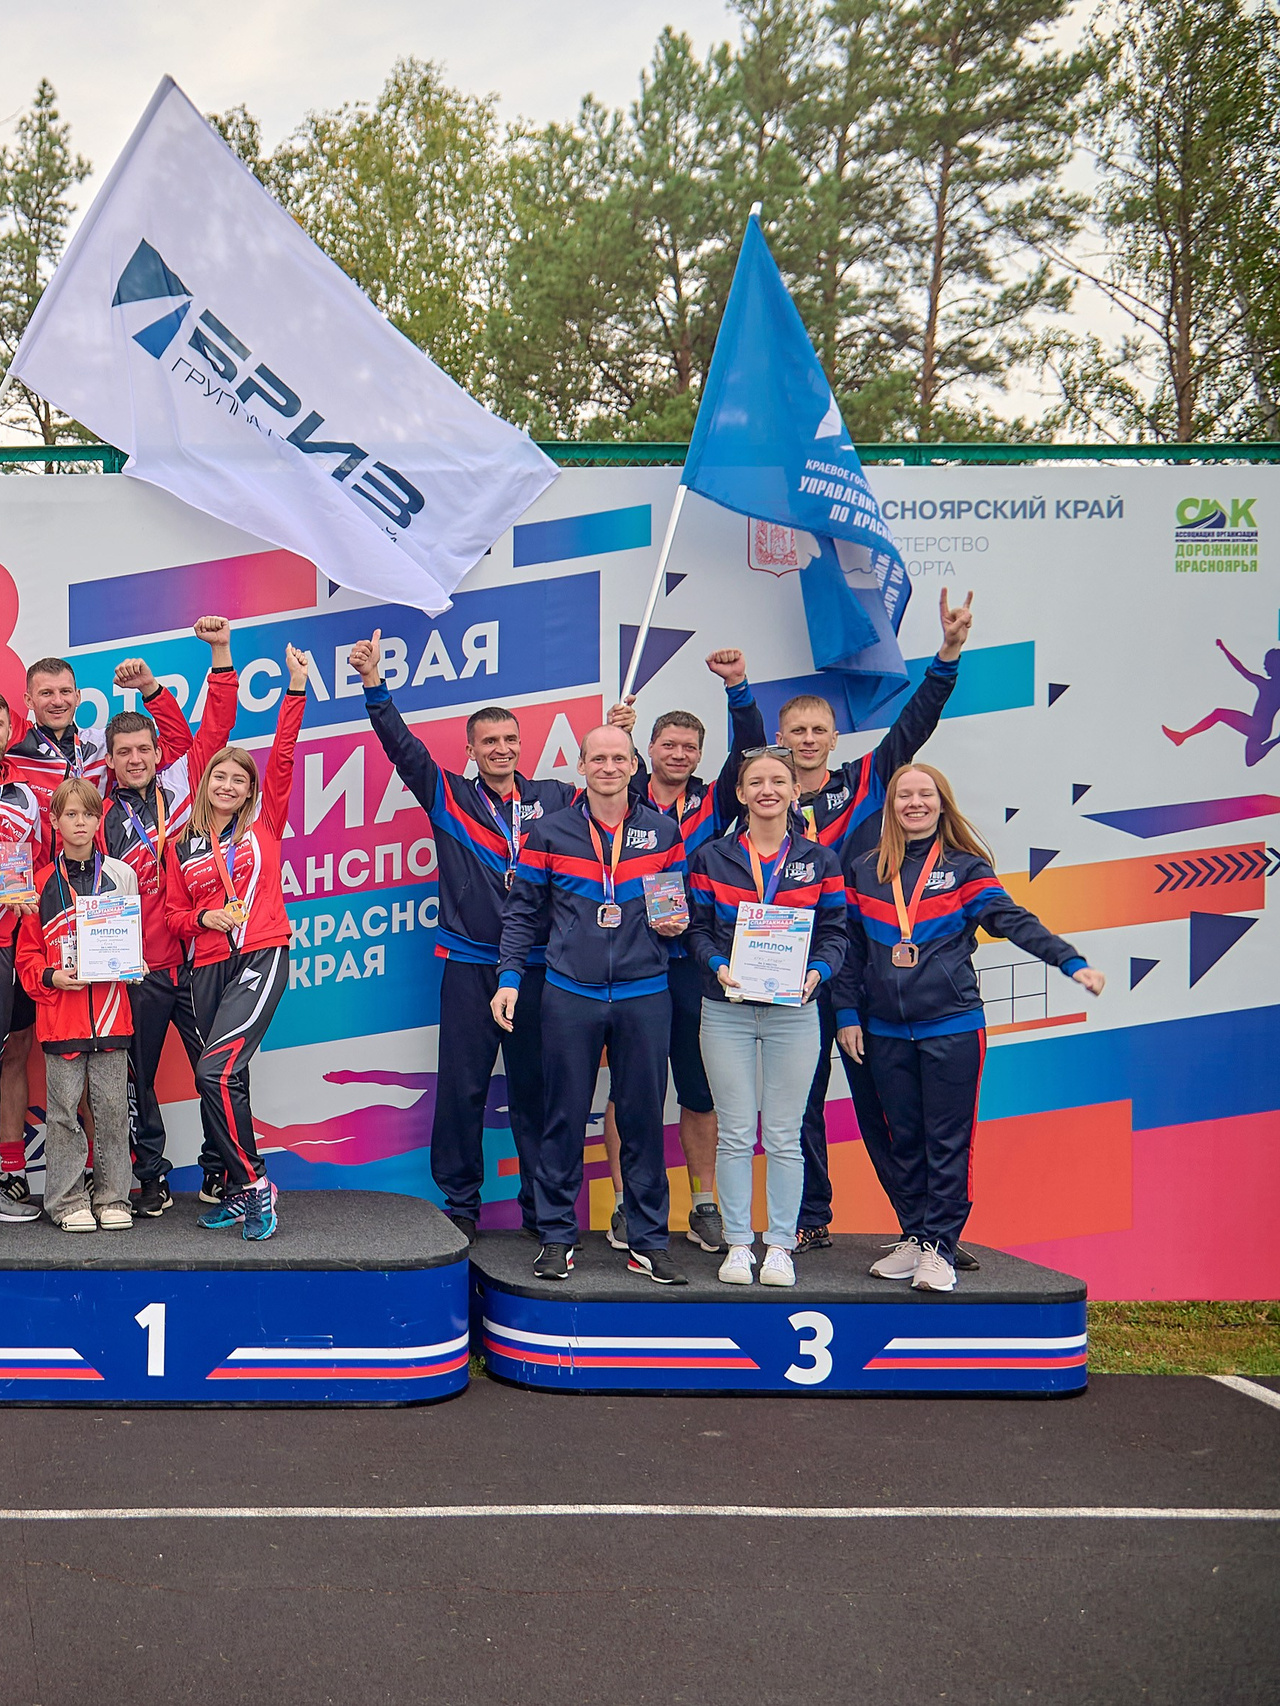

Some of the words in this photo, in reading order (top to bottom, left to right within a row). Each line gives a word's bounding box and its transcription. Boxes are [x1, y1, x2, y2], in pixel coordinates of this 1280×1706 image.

[171, 356, 262, 432] ГРУПА
[188, 308, 425, 529] БРИЗ
[805, 458, 850, 479] КРАЕВОЕ
[849, 472, 874, 494] ГОСУ
[798, 475, 878, 515] УПРАВЛЕНИЕ
[881, 495, 1046, 520] СНОЯРСКИЙ
[1055, 494, 1124, 519] КРАЙ
[829, 503, 851, 523] ПО
[852, 510, 895, 543] КРАСН
[892, 536, 990, 553] СТЕРСТВО
[1175, 544, 1258, 558] ДОРОЖНИКИ
[907, 560, 956, 577] ОРТА
[1175, 560, 1258, 573] КРАСНОЯРЬЯ
[281, 837, 440, 897] АНСПО
[85, 899, 98, 911] 18
[673, 894, 688, 912] 3
[748, 908, 764, 920] 18
[289, 896, 440, 950] КРАСНО
[748, 940, 793, 953] ДИПЛОМ
[289, 944, 386, 990] КРАЯ
[134, 1303, 166, 1376] 1
[783, 1310, 834, 1385] 3
